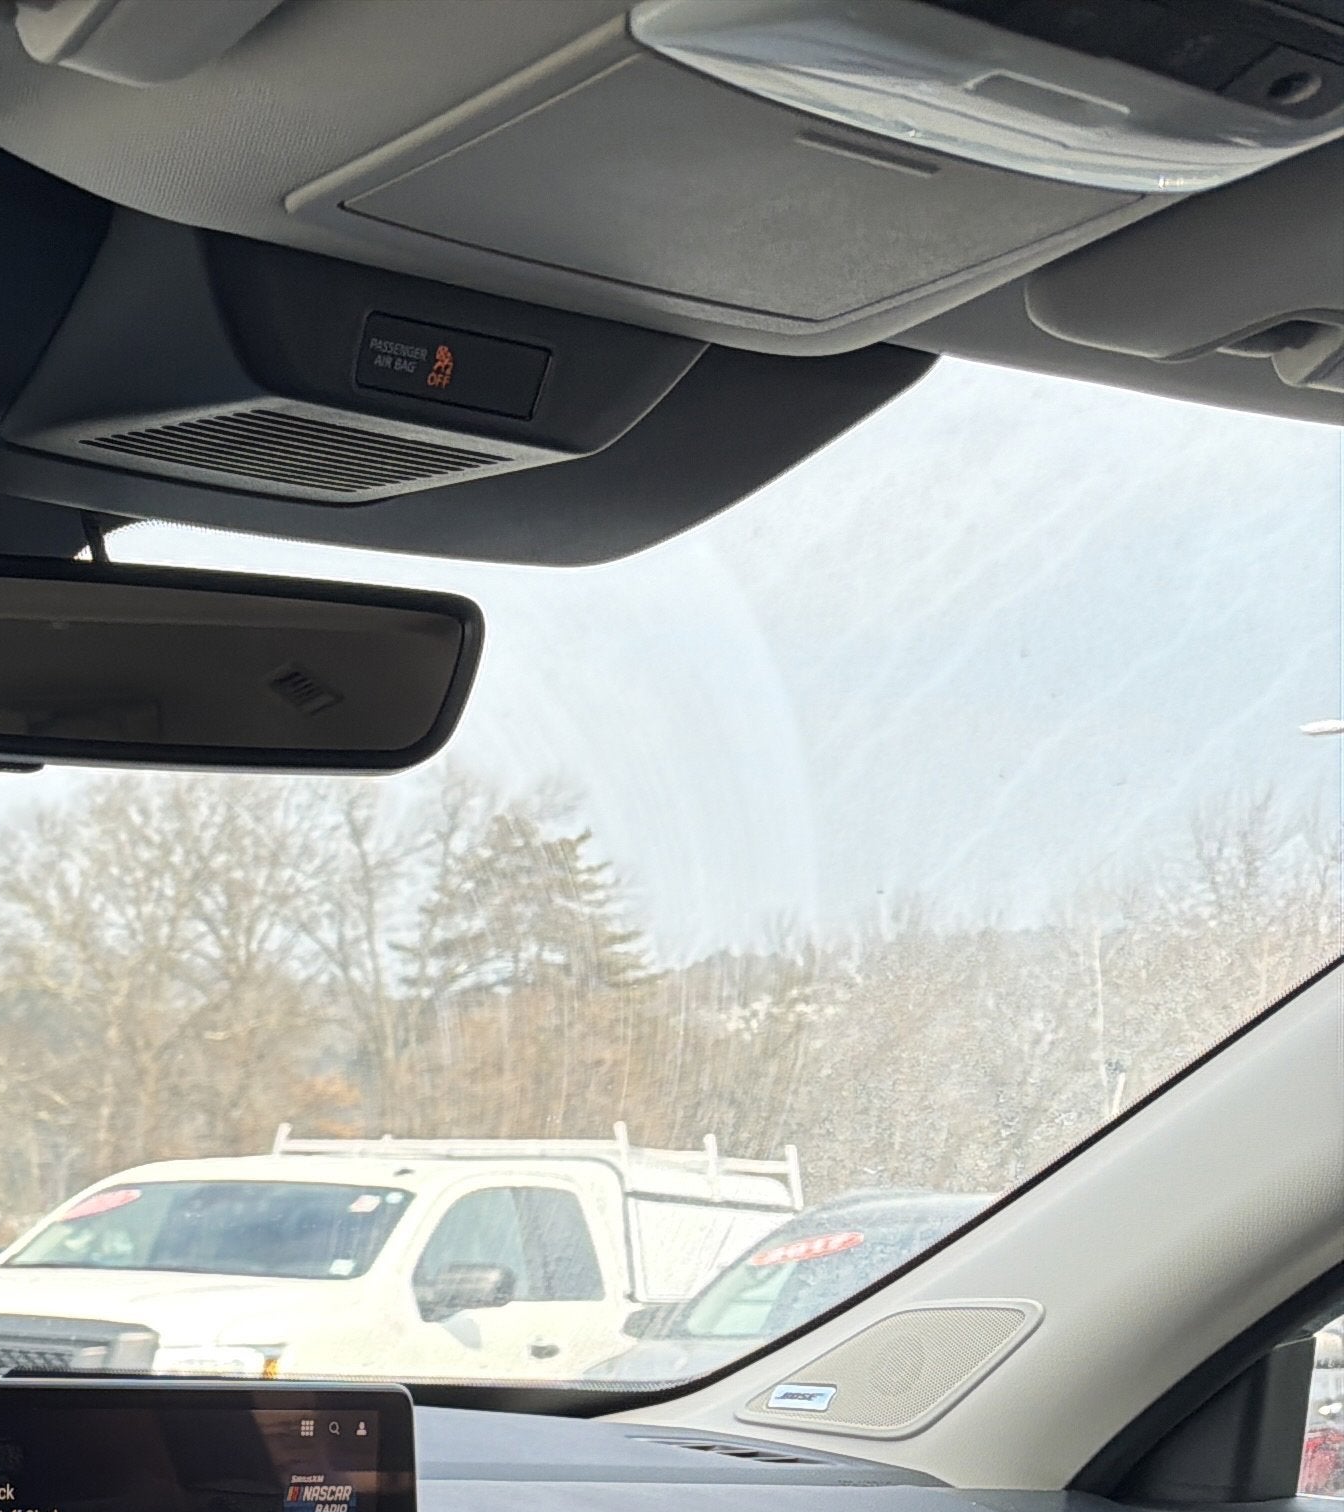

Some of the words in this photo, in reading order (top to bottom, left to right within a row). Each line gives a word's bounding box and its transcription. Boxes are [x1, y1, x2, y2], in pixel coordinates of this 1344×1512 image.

[370, 338, 428, 360] PASSENGER
[374, 354, 392, 368] AIR
[394, 357, 417, 373] BAG
[427, 372, 451, 388] OFF
[303, 1485, 352, 1501] NASCAR
